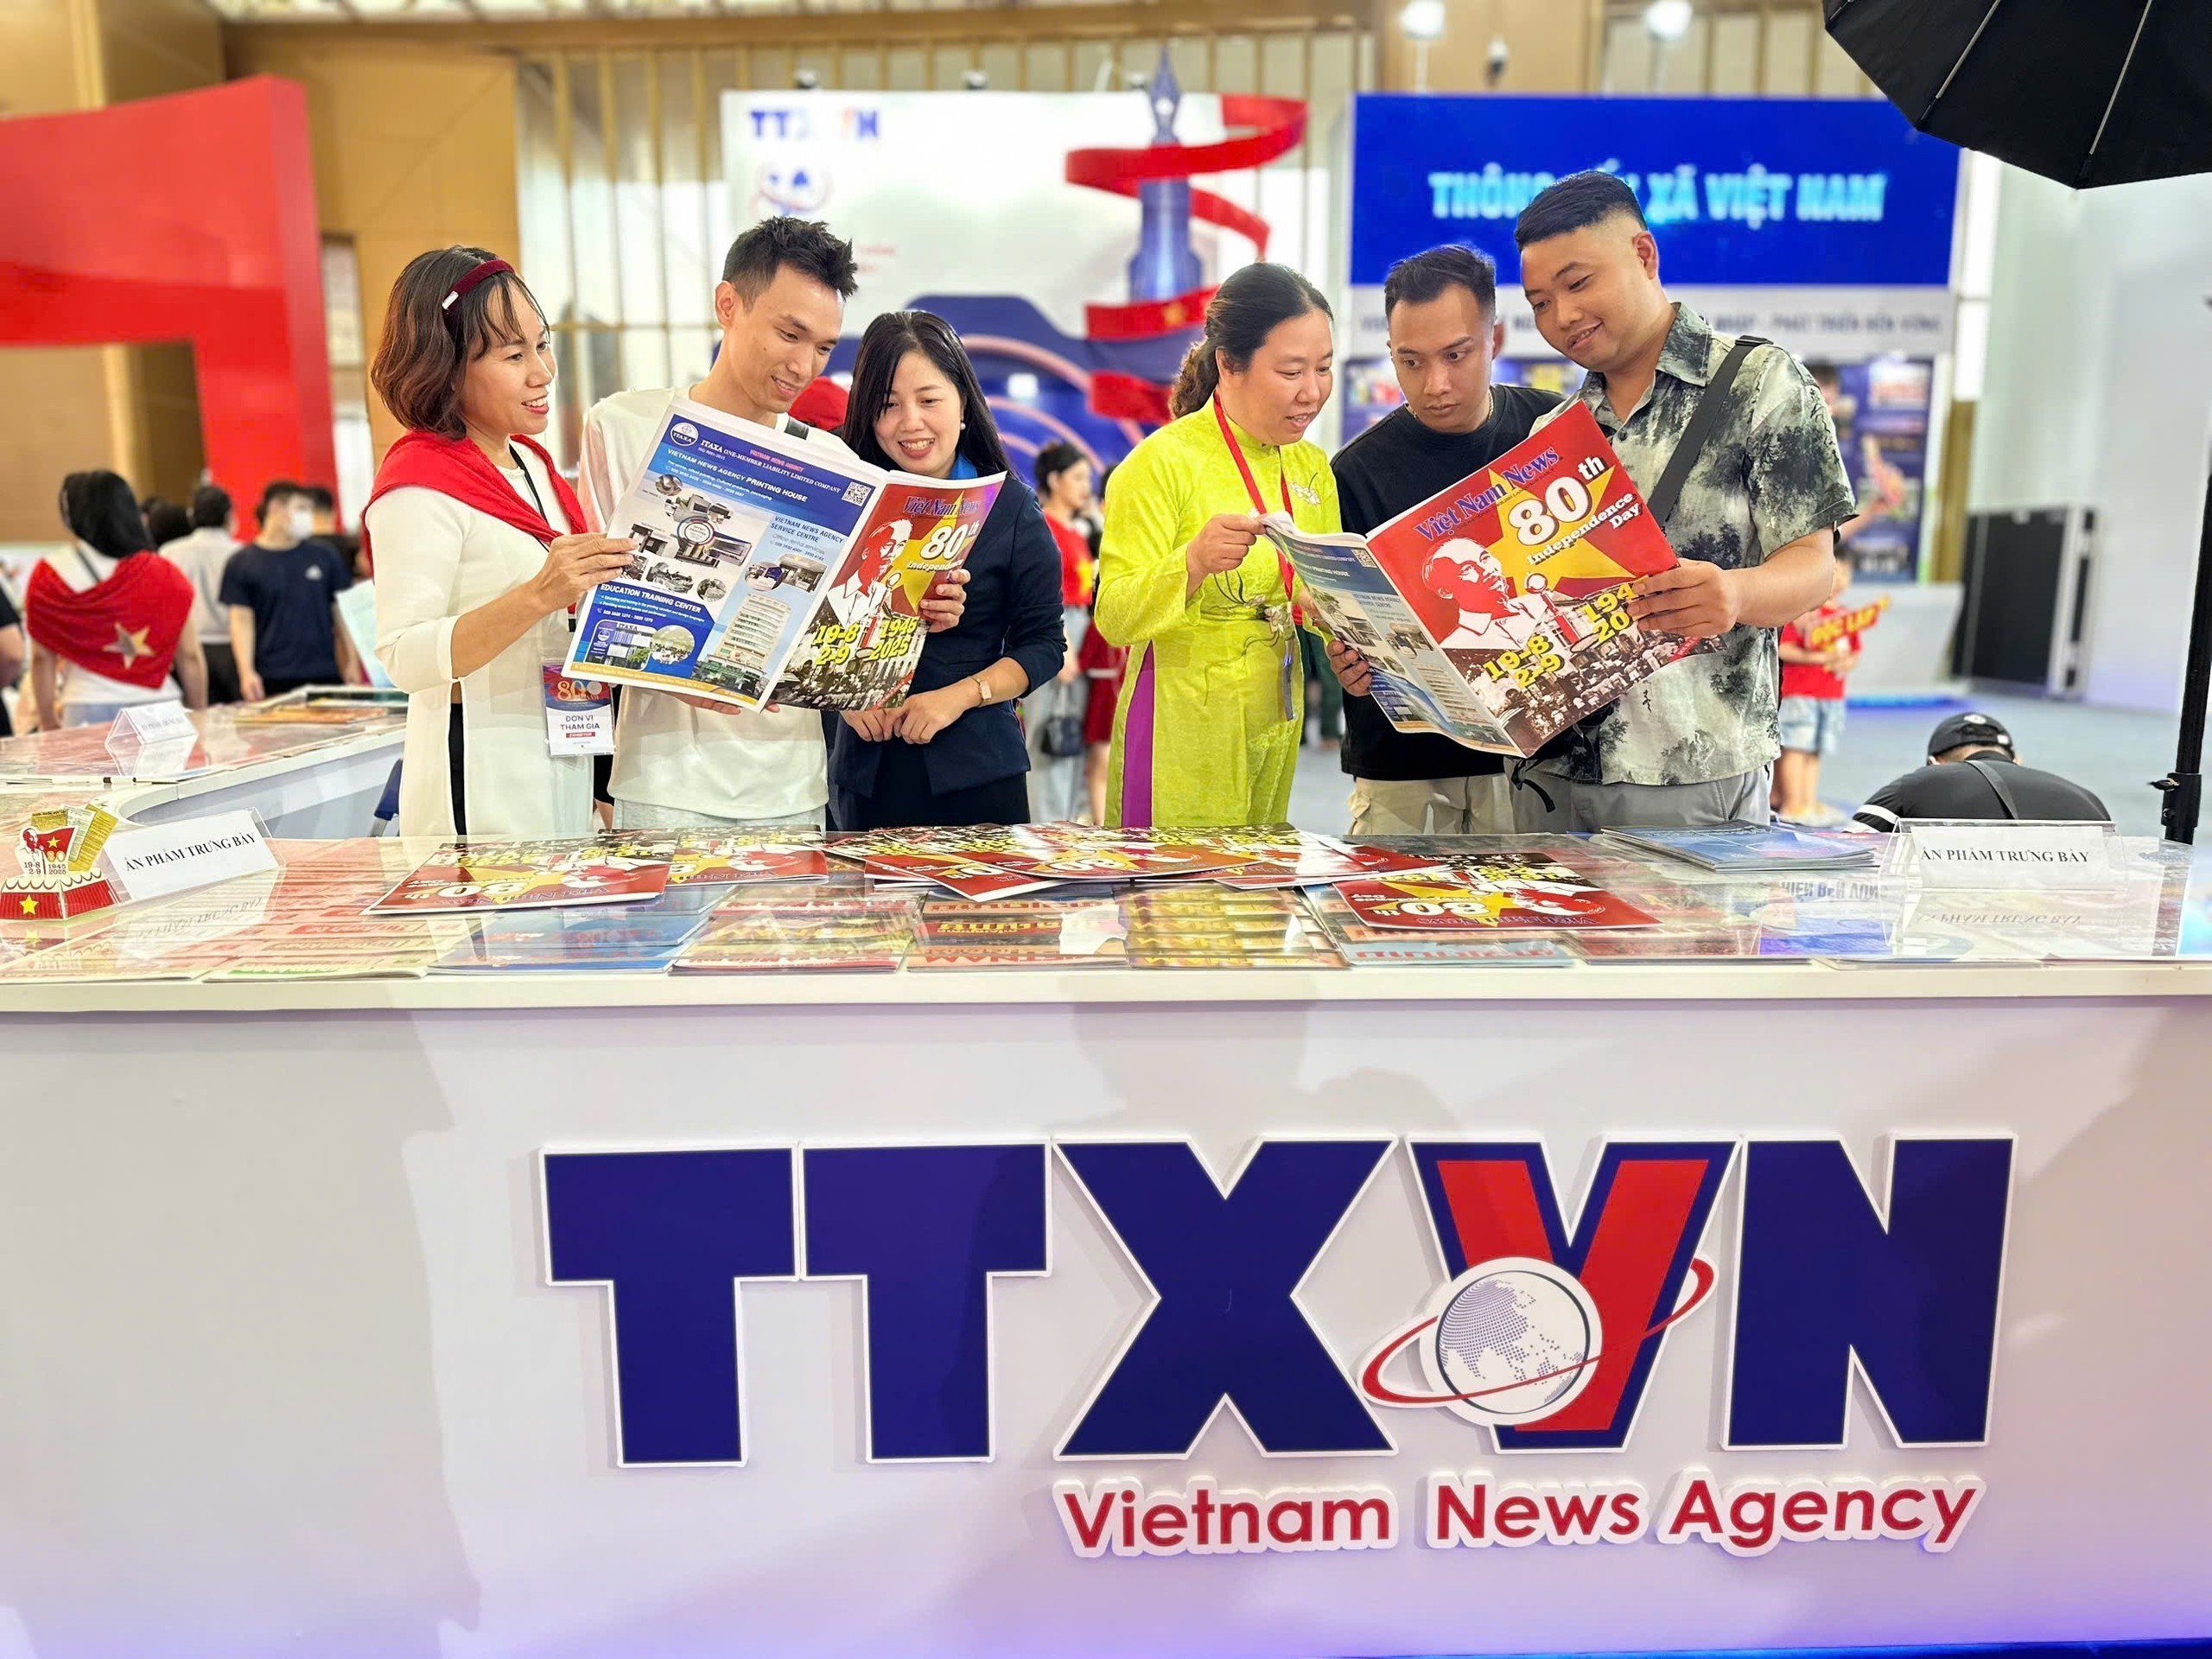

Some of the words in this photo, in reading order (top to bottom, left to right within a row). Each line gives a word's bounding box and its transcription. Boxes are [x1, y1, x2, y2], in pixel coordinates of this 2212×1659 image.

[1704, 163, 1793, 230] VIỆT
[1796, 172, 1887, 221] NAM
[667, 448, 697, 464] VIETNAM
[697, 461, 717, 472] NEWS
[718, 467, 745, 481] AGENCY
[746, 477, 781, 493] PRINTING
[782, 489, 808, 502] HOUSE
[701, 439, 722, 454] ITAXA
[723, 449, 762, 467] ONE-MEMBER
[763, 463, 790, 477] LIABILITY
[790, 473, 814, 485] LIMITED
[814, 480, 841, 493] COMPANY
[931, 499, 957, 517] Nam
[1414, 510, 1460, 543] Việt
[1455, 483, 1508, 520] Nam
[1502, 446, 1560, 491] News
[1508, 476, 1592, 547] 80
[1578, 455, 1607, 481] th
[775, 516, 801, 529] VIETNAM
[802, 524, 819, 534] NEWS
[820, 531, 844, 543] AGENCY
[1526, 492, 1637, 567] Independence
[1608, 504, 1643, 531] Day
[770, 523, 795, 535] SERVICE
[796, 531, 820, 543] CENTRE
[919, 524, 969, 560] 80
[968, 520, 980, 537] th
[601, 583, 640, 597] EDUCATION
[641, 591, 674, 606] TRAINING
[674, 601, 702, 613] CENTER
[1580, 577, 1646, 623] 194
[813, 622, 861, 645] 19-8
[879, 616, 920, 640] 1945
[815, 645, 851, 667] 2-9
[863, 637, 911, 662] 2025
[1483, 635, 1554, 681] 19-8
[1514, 653, 1566, 689] 2-9
[185, 838, 232, 858] TRƯNG
[1995, 849, 2054, 863] TRƯNG
[2058, 849, 2089, 863] BÀY
[1396, 900, 1491, 916] 80
[1417, 917, 1481, 926] News
[544, 1139, 2012, 1465] TTXVN
[1061, 1489, 1392, 1547] Vietnam
[1437, 1483, 1641, 1541] News
[1668, 1478, 1980, 1549] Agency
